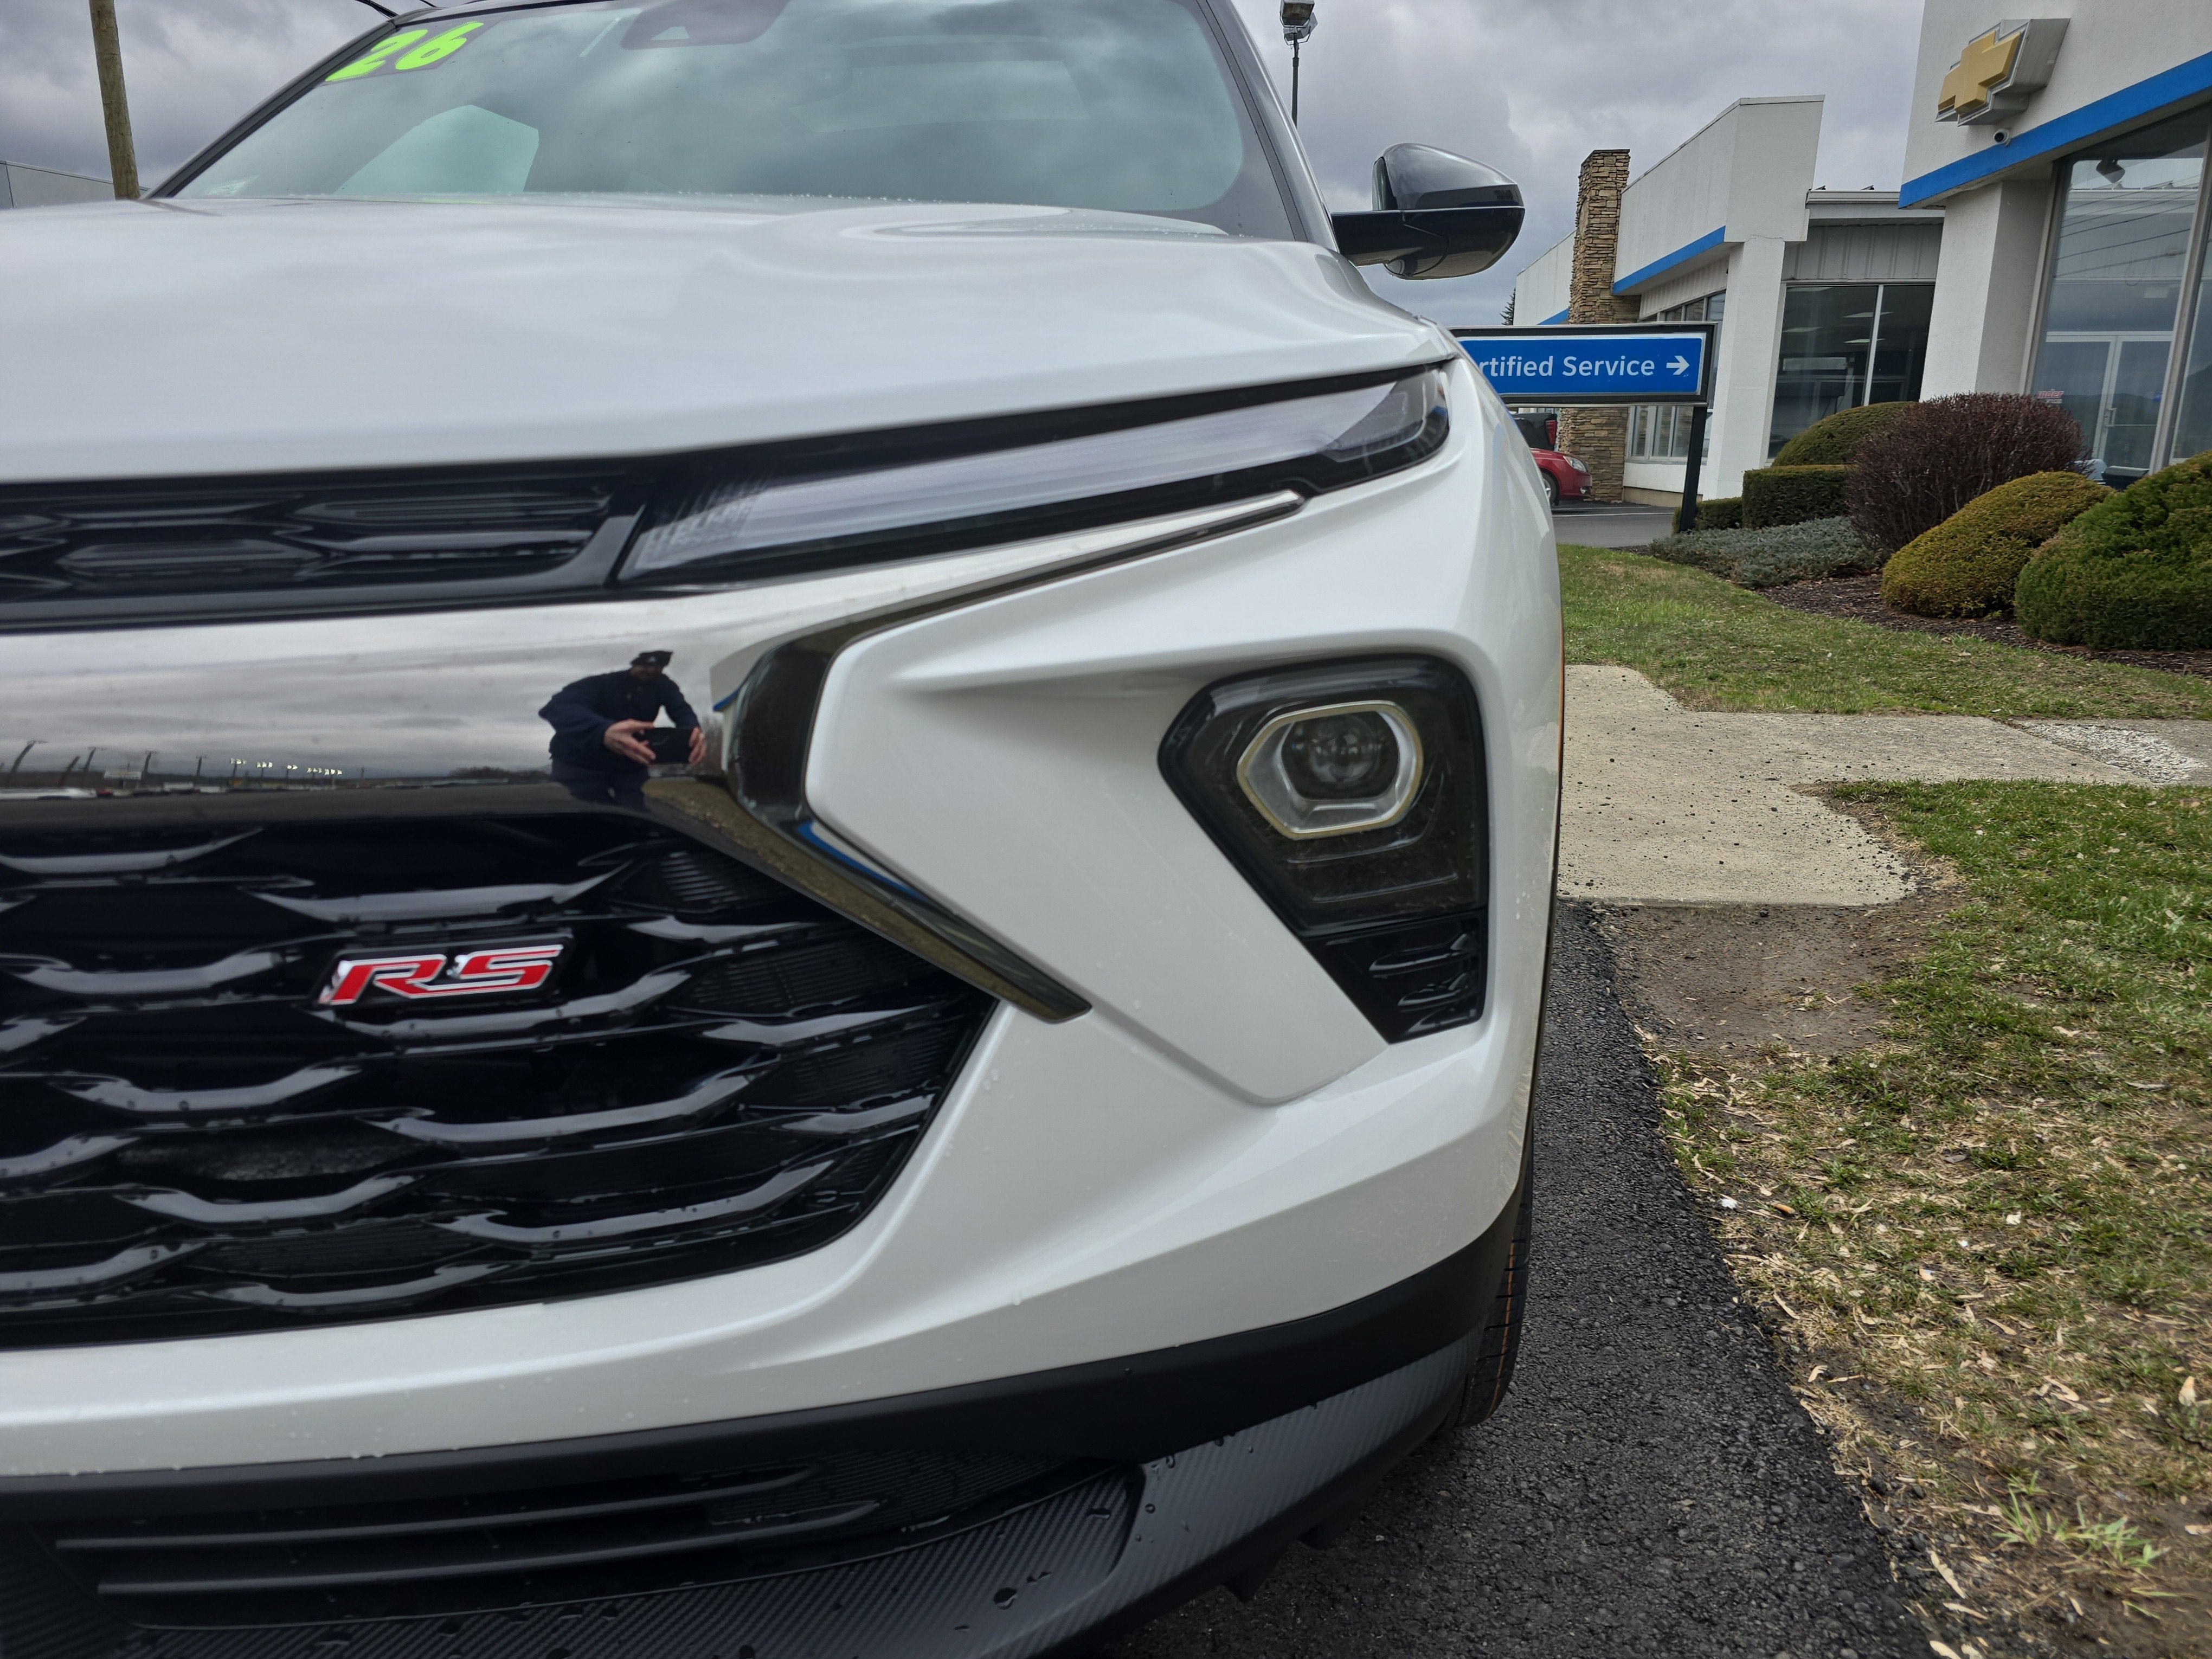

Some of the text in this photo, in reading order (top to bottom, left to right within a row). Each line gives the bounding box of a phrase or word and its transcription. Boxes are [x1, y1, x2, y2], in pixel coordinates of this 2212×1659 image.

[325, 21, 484, 81] 26
[1479, 356, 1655, 376] rtified Service
[318, 944, 564, 1006] RS
